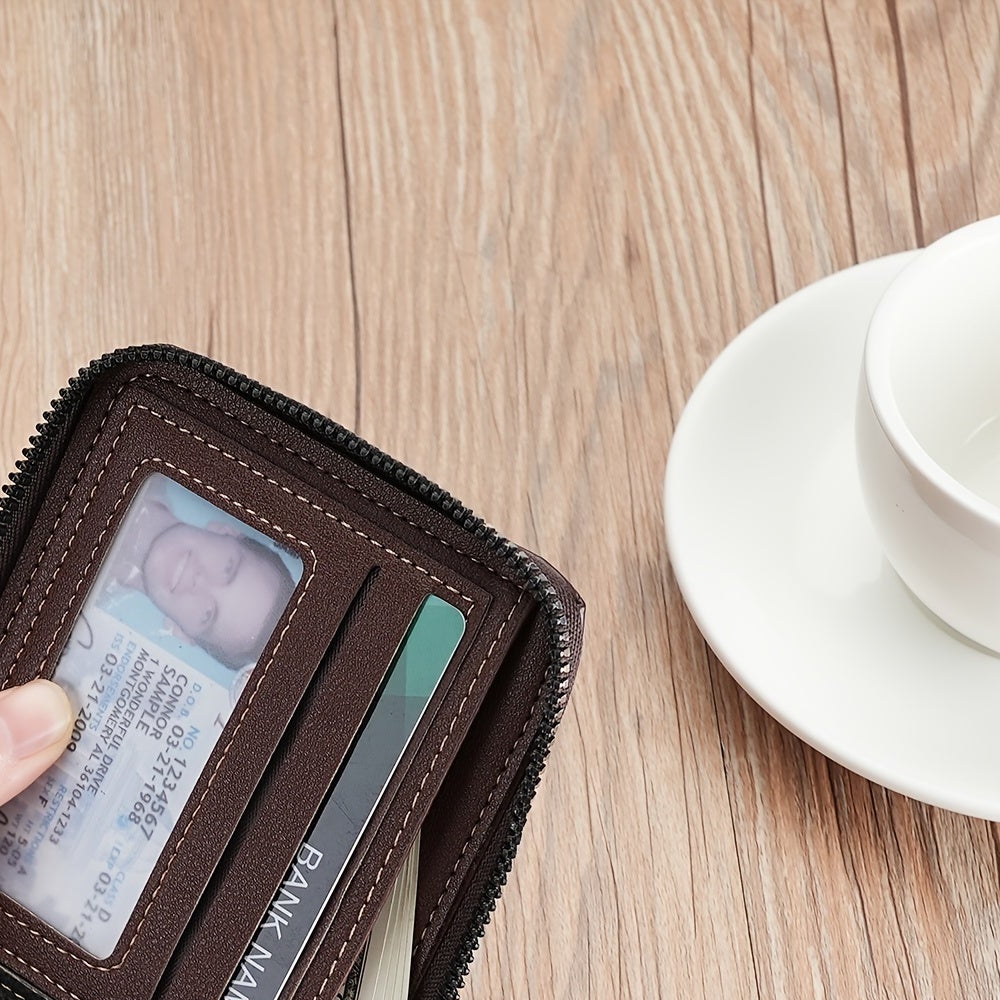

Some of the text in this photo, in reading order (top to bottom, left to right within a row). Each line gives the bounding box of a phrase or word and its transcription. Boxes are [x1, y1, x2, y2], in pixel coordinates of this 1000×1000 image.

[89, 640, 137, 731] ENDORSEMENTS
[107, 671, 155, 750] WONDERFUL
[135, 664, 176, 735] SAMPLE
[149, 674, 188, 740] CONNOR
[49, 648, 150, 845] MONTGOMERY AL 36104-1233
[87, 755, 113, 797] DRIVE
[128, 725, 184, 825] 03-21-1968
[38, 794, 48, 808] F
[140, 757, 187, 841] 1234567
[0, 830, 16, 856] 120
[98, 909, 112, 923] D
[260, 842, 324, 940] BANK
